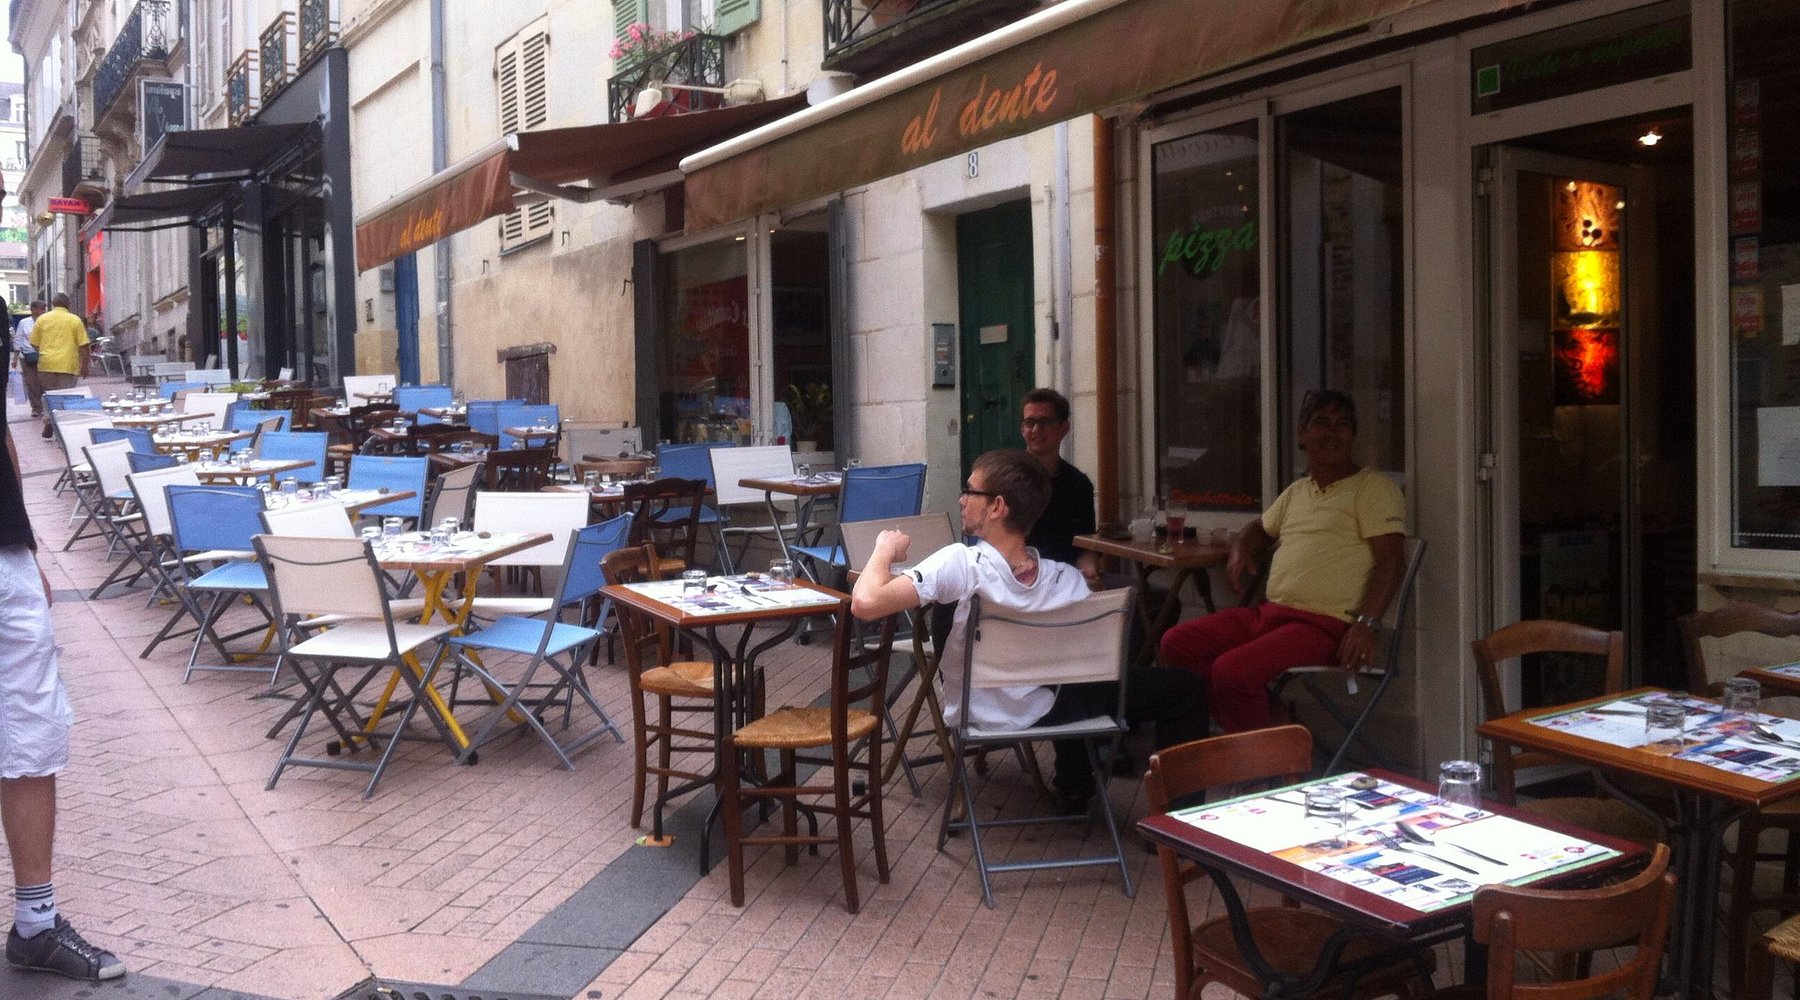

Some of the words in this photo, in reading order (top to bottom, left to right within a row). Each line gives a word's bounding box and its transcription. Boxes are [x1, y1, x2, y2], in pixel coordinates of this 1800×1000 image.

[902, 87, 941, 154] al
[960, 63, 1057, 135] dente
[969, 153, 978, 178] 8
[400, 214, 412, 249] al
[1159, 223, 1256, 274] pizza
